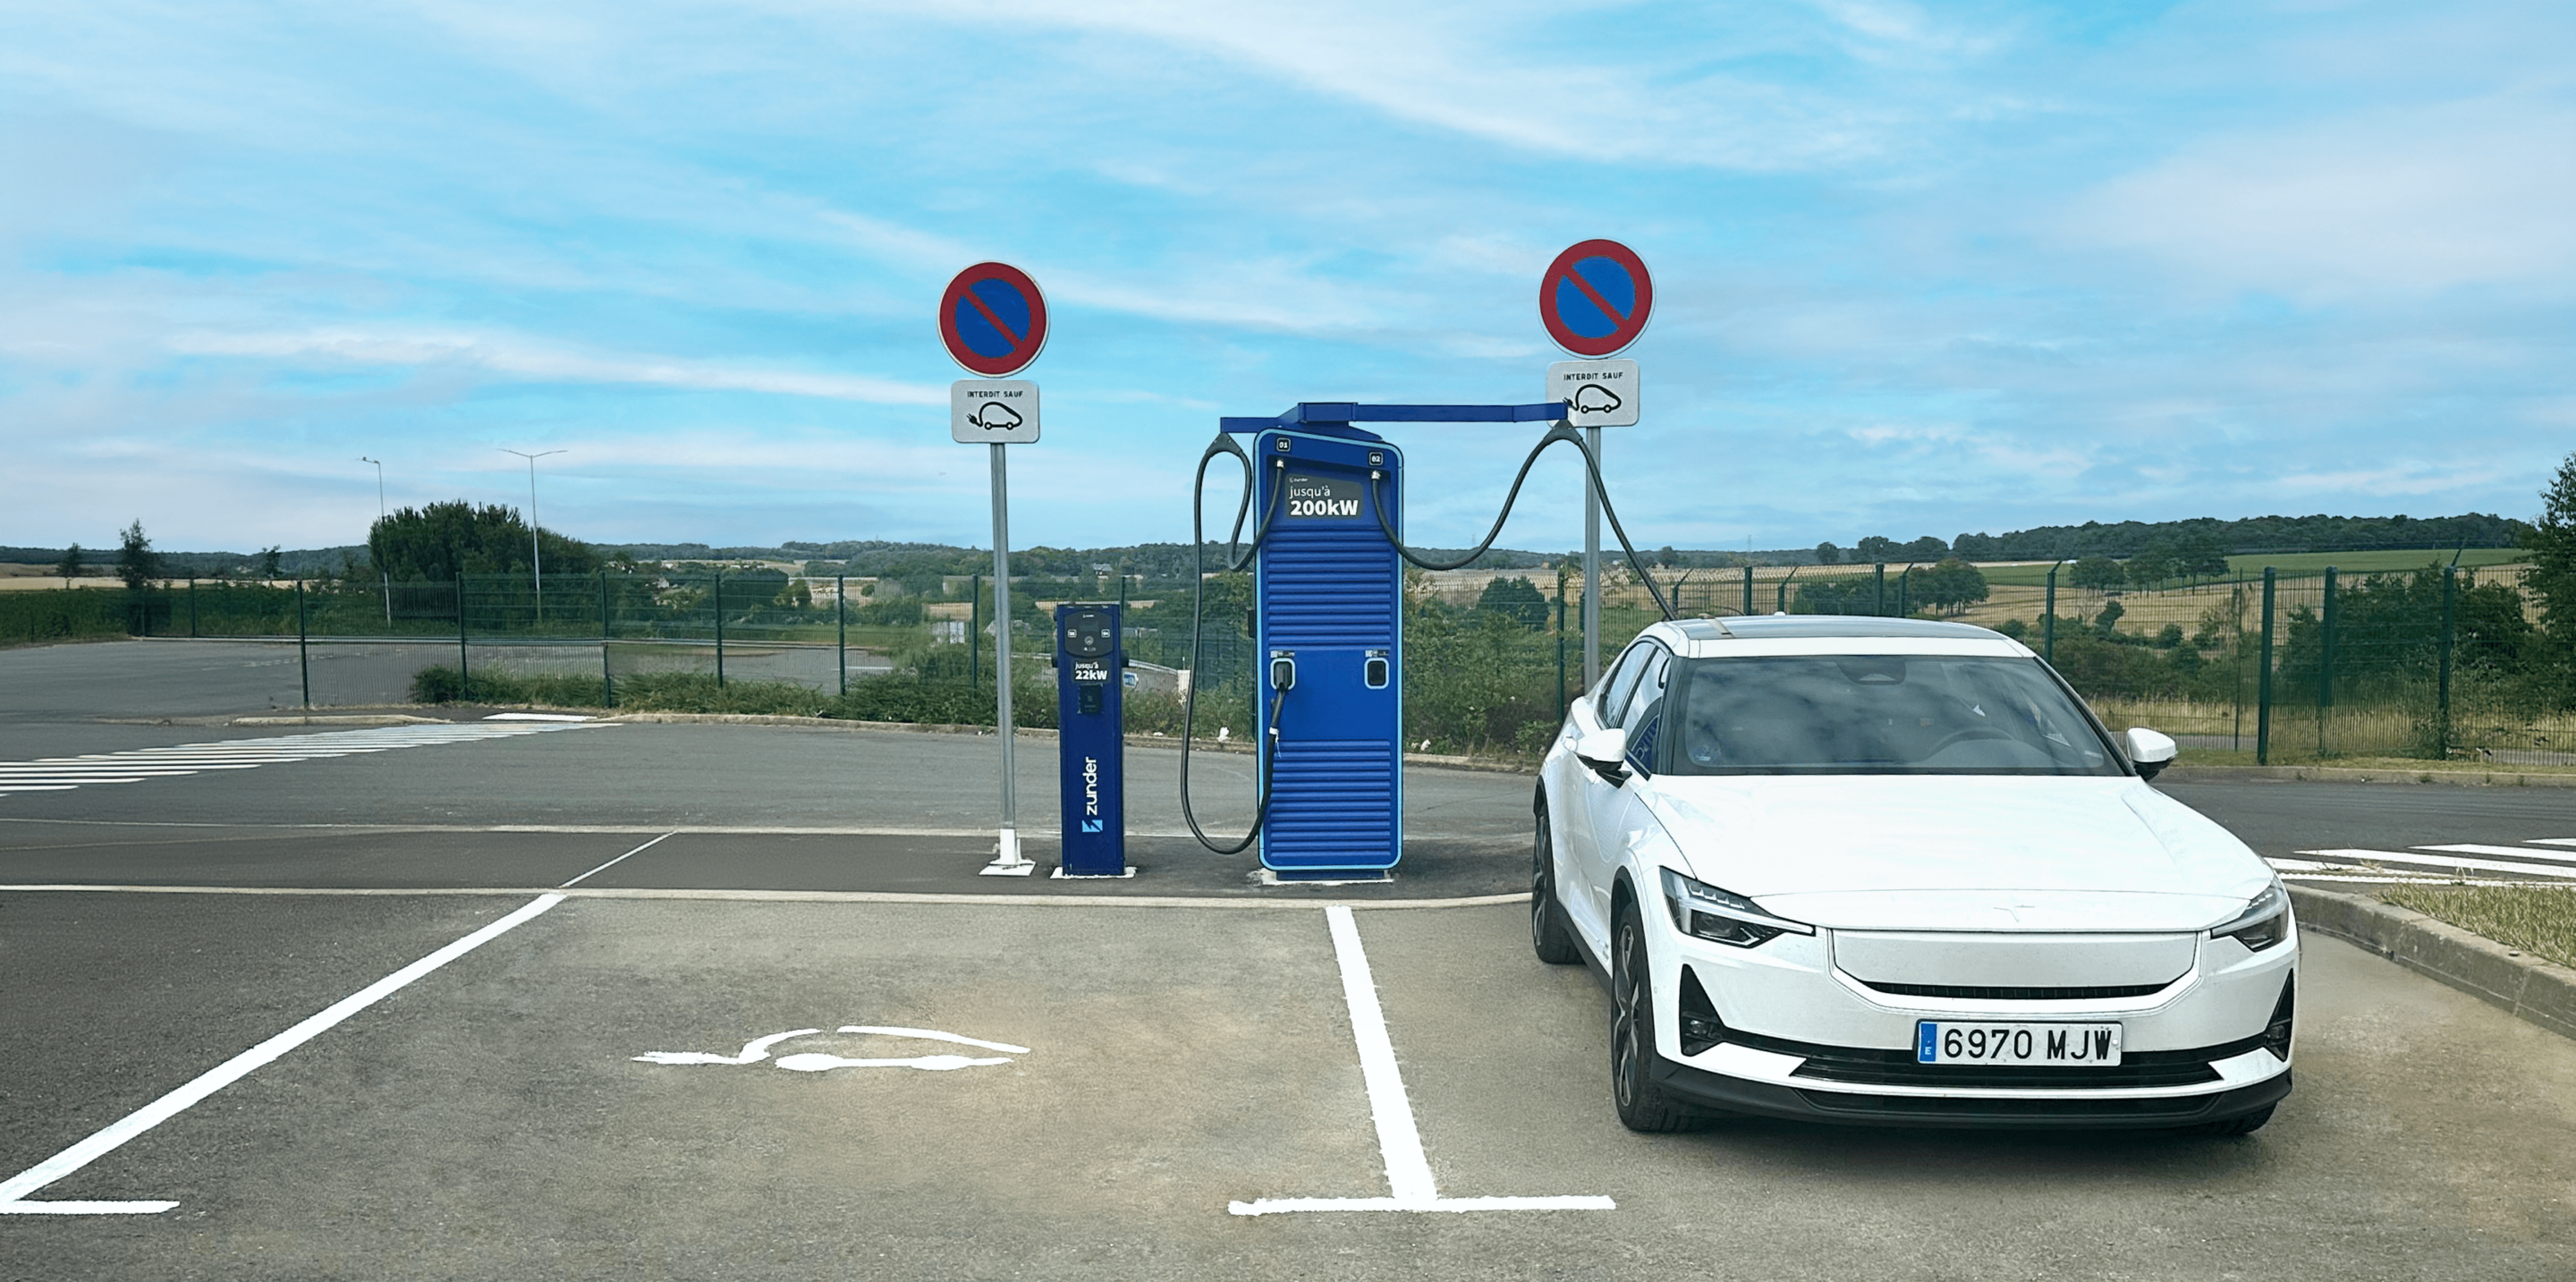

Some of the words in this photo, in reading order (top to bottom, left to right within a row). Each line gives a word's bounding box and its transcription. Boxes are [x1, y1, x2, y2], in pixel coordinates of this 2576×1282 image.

[1563, 373, 1598, 381] INTERDIT
[1289, 485, 1331, 499] jusqu'à
[1290, 499, 1359, 516] 200kW
[1075, 670, 1107, 680] 22kW
[1082, 757, 1097, 816] zunder
[1924, 1046, 1932, 1056] E
[1944, 1029, 2032, 1059] 6970
[2046, 1030, 2112, 1060] MJW
